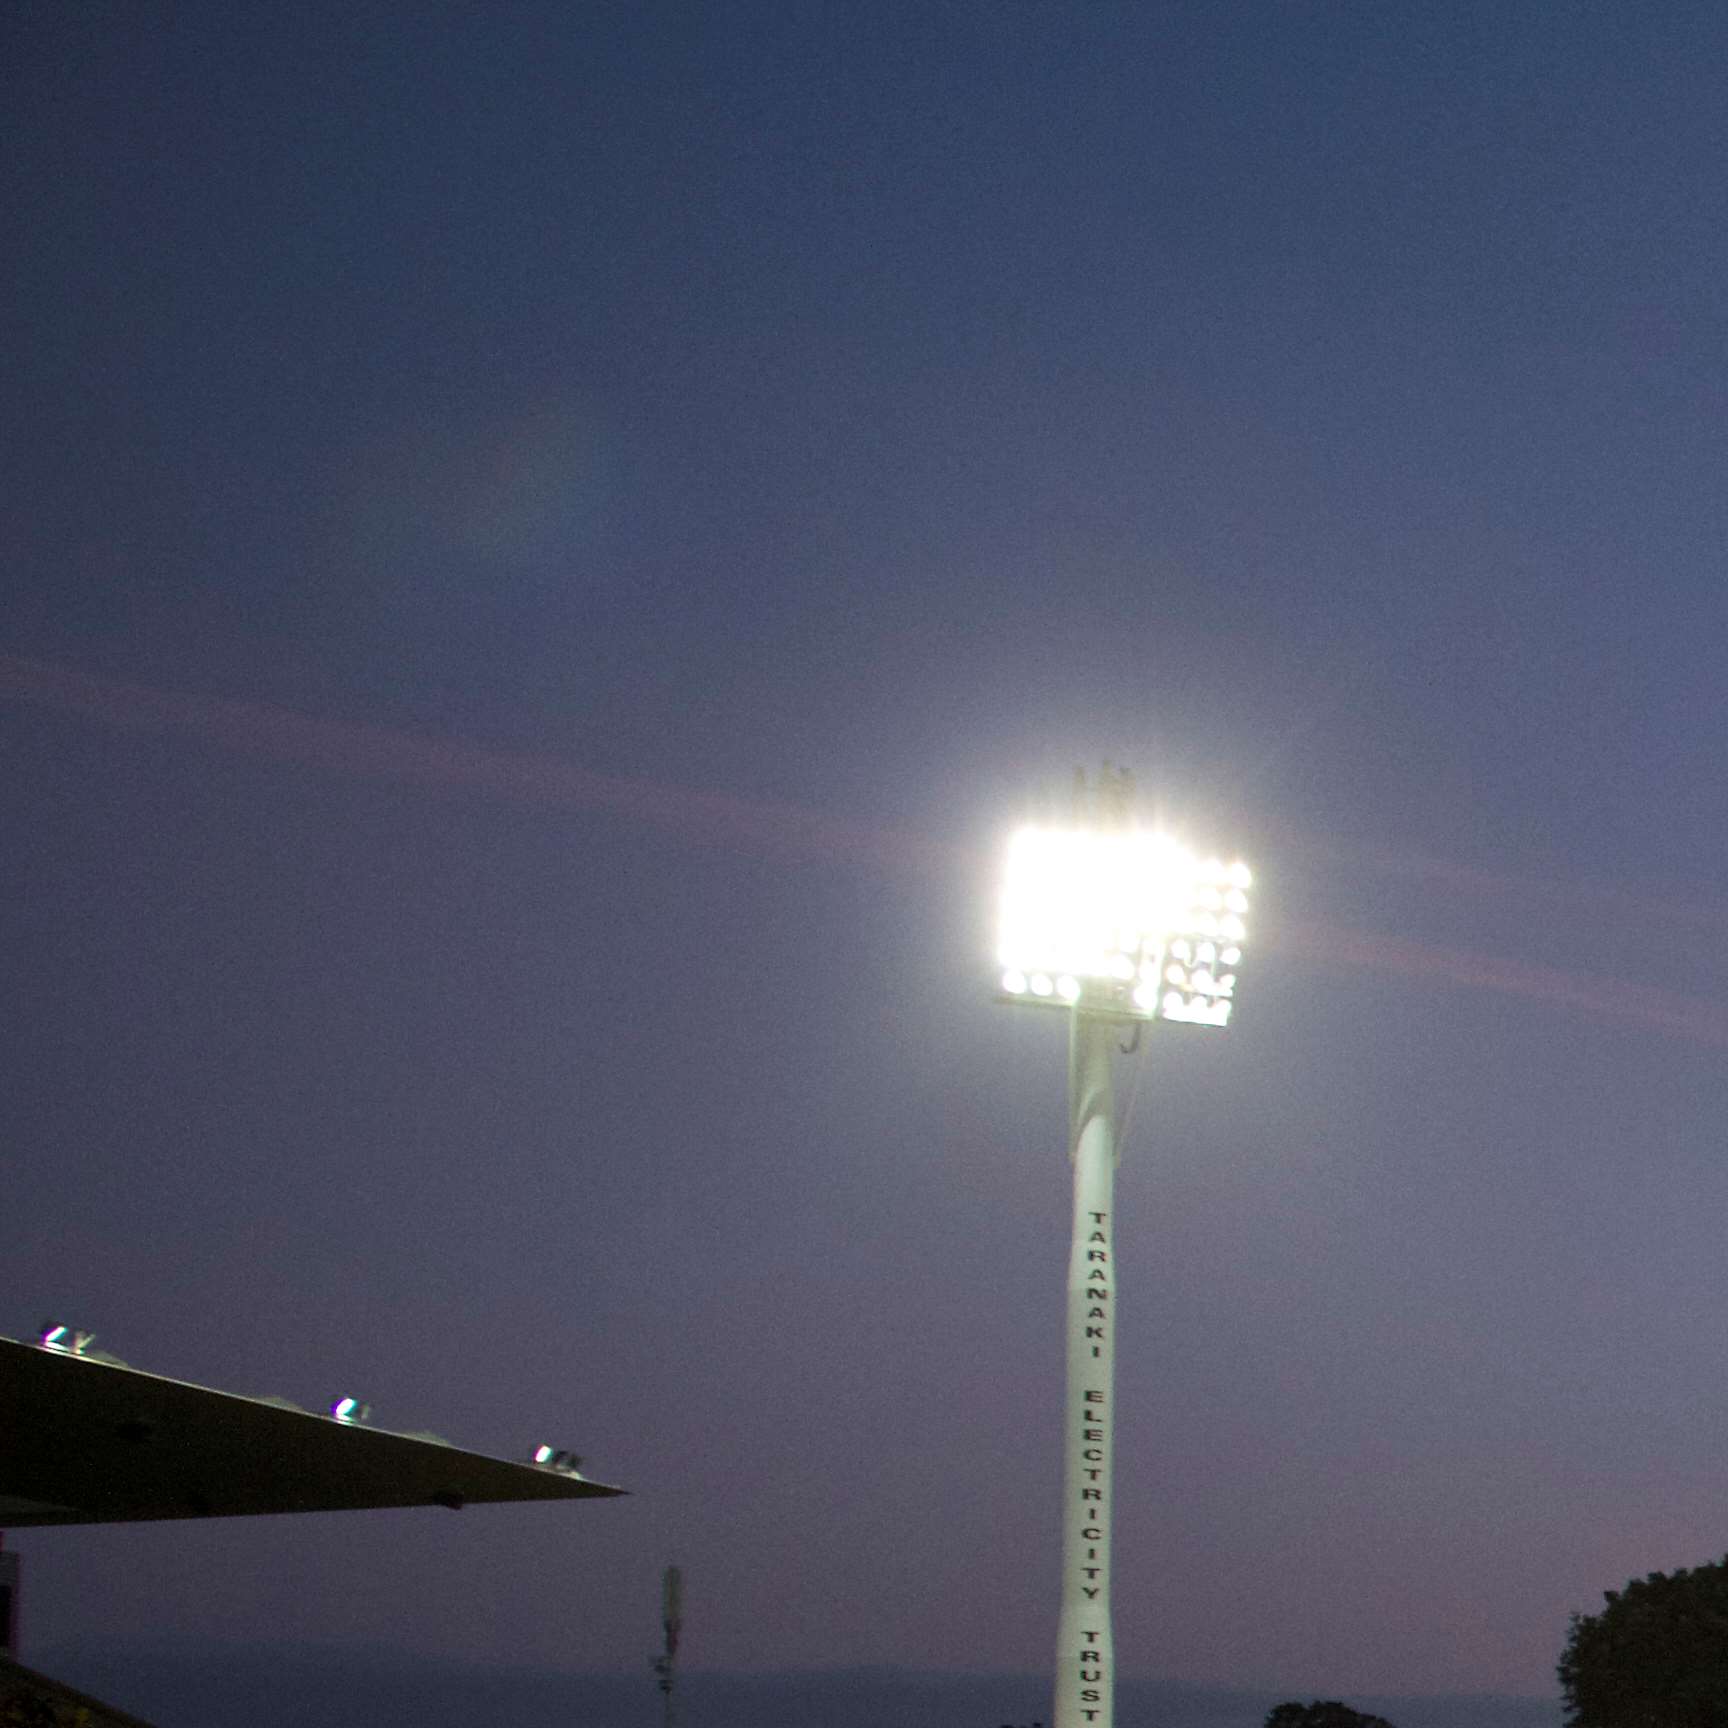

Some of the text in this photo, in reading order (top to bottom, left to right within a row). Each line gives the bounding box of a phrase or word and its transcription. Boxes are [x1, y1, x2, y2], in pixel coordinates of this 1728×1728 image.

[1079, 1211, 1109, 1723] TARANAKI ELECTRICITY TRUST
